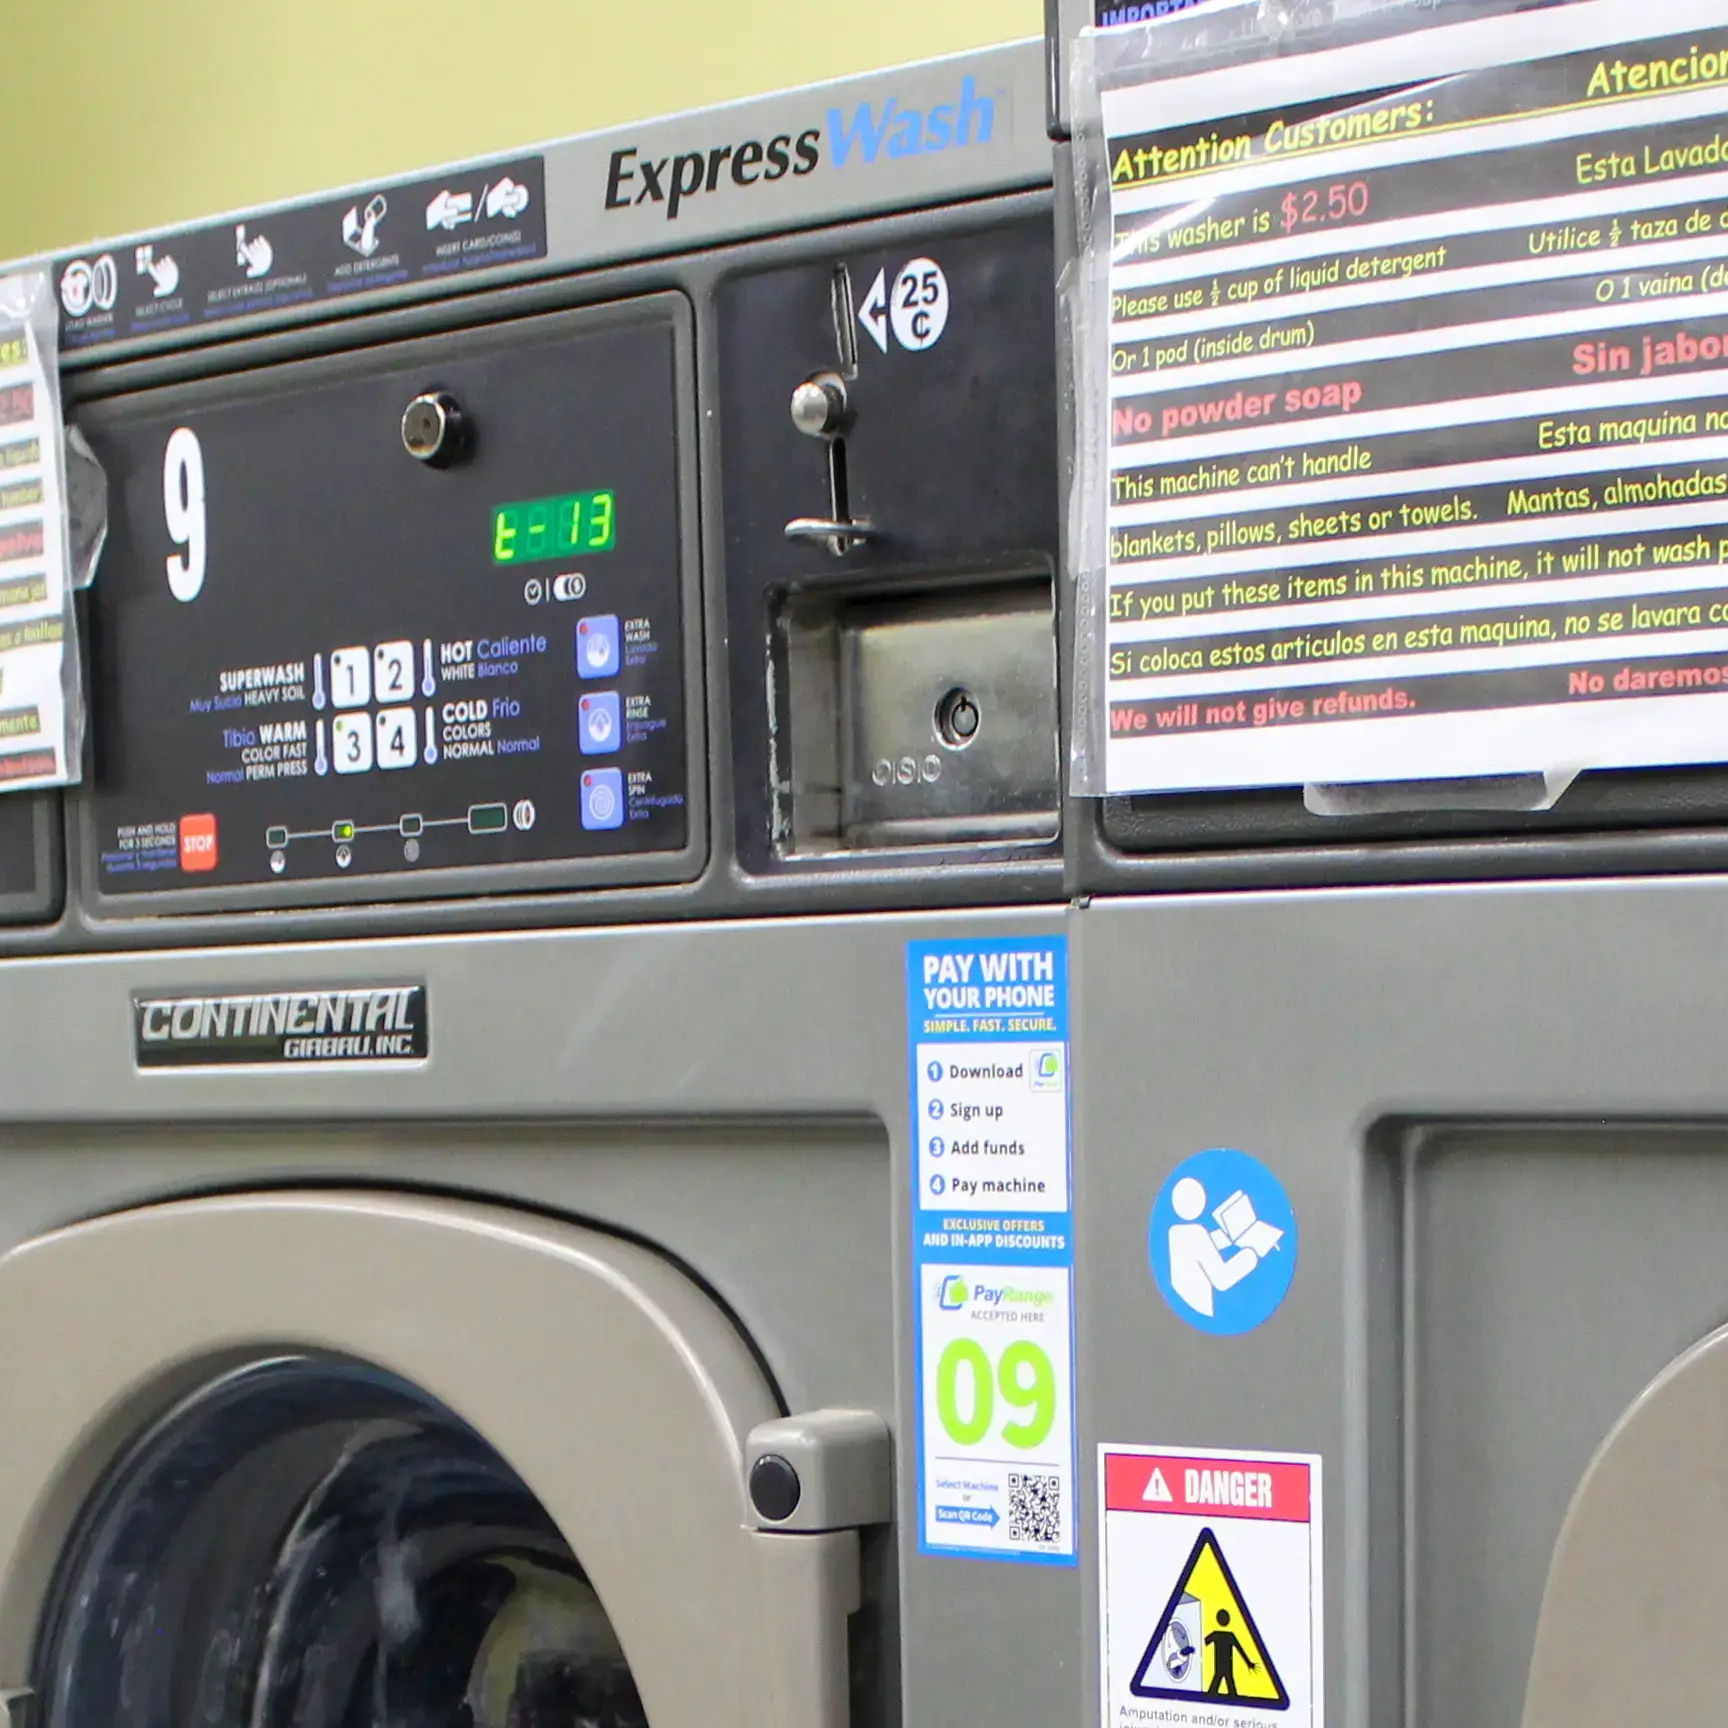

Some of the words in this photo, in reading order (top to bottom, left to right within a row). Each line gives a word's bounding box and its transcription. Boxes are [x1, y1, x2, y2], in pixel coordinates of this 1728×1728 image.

[1113, 133, 1251, 182] Attention
[1264, 100, 1434, 155] Customers:
[1576, 152, 1636, 184] Esta
[1168, 214, 1245, 250] washer
[1252, 208, 1270, 234] is
[1281, 180, 1368, 234] $2.50
[901, 270, 939, 309] 25
[1572, 338, 1630, 375] Sin
[1113, 408, 1152, 437] No
[1162, 390, 1276, 437] powder
[1285, 380, 1362, 413] soap
[1538, 421, 1591, 449] Esta
[1599, 411, 1696, 445] maquina
[1113, 474, 1153, 500] This
[1160, 462, 1239, 495] machine
[1302, 446, 1372, 477] handle
[163, 427, 206, 602] 9
[1507, 488, 1598, 516] Mantas,
[1110, 531, 1202, 559] blankets,
[1206, 521, 1284, 552] pillows,
[1289, 510, 1361, 541] sheets
[1368, 509, 1393, 530] or
[1399, 495, 1479, 527] towels.
[441, 640, 473, 664] HOT
[477, 633, 547, 658] Caliente
[220, 664, 305, 692] SUPERWASH
[345, 665, 354, 697] 1
[388, 658, 403, 691] 2
[1568, 670, 1604, 695] No
[442, 700, 488, 724] COLD
[492, 699, 520, 718] Frio
[1110, 707, 1147, 733] We
[1156, 703, 1197, 729] will
[1206, 700, 1245, 726] not
[1253, 695, 1303, 726] give
[1312, 687, 1416, 717] refunds.
[223, 727, 255, 747] Tibio
[259, 721, 307, 742] WARM
[347, 731, 361, 762] 3
[390, 725, 405, 757] 4
[183, 833, 214, 854] STOP
[923, 954, 974, 984] PAY
[980, 952, 1054, 982] WITH
[924, 987, 980, 1010] YOUR
[985, 984, 1054, 1008] PHONE
[141, 987, 419, 1041] CONTINENTAL
[924, 1020, 970, 1033] SIMPLE.
[973, 1019, 1005, 1032] FAST.
[1008, 1018, 1056, 1032] SECURE.
[950, 1064, 1023, 1079] Download
[950, 1102, 980, 1121] Sign
[986, 1104, 1003, 1121] up
[951, 1141, 978, 1155] Add
[984, 1140, 1025, 1155] funds
[952, 1178, 977, 1196] Pay
[983, 1176, 1046, 1192] machine
[924, 1233, 948, 1246] AND
[951, 1233, 992, 1248] IN-APP
[995, 1233, 1065, 1249] DISCOUNTS
[973, 1285, 1054, 1305] PayRange
[971, 1310, 1019, 1322] ACCEPTED
[1021, 1311, 1045, 1323] HERE
[936, 1337, 1057, 1449] 09
[1185, 1469, 1272, 1508] DANGER
[1120, 1706, 1187, 1723] Amputation
[1192, 1715, 1229, 1727] and/or
